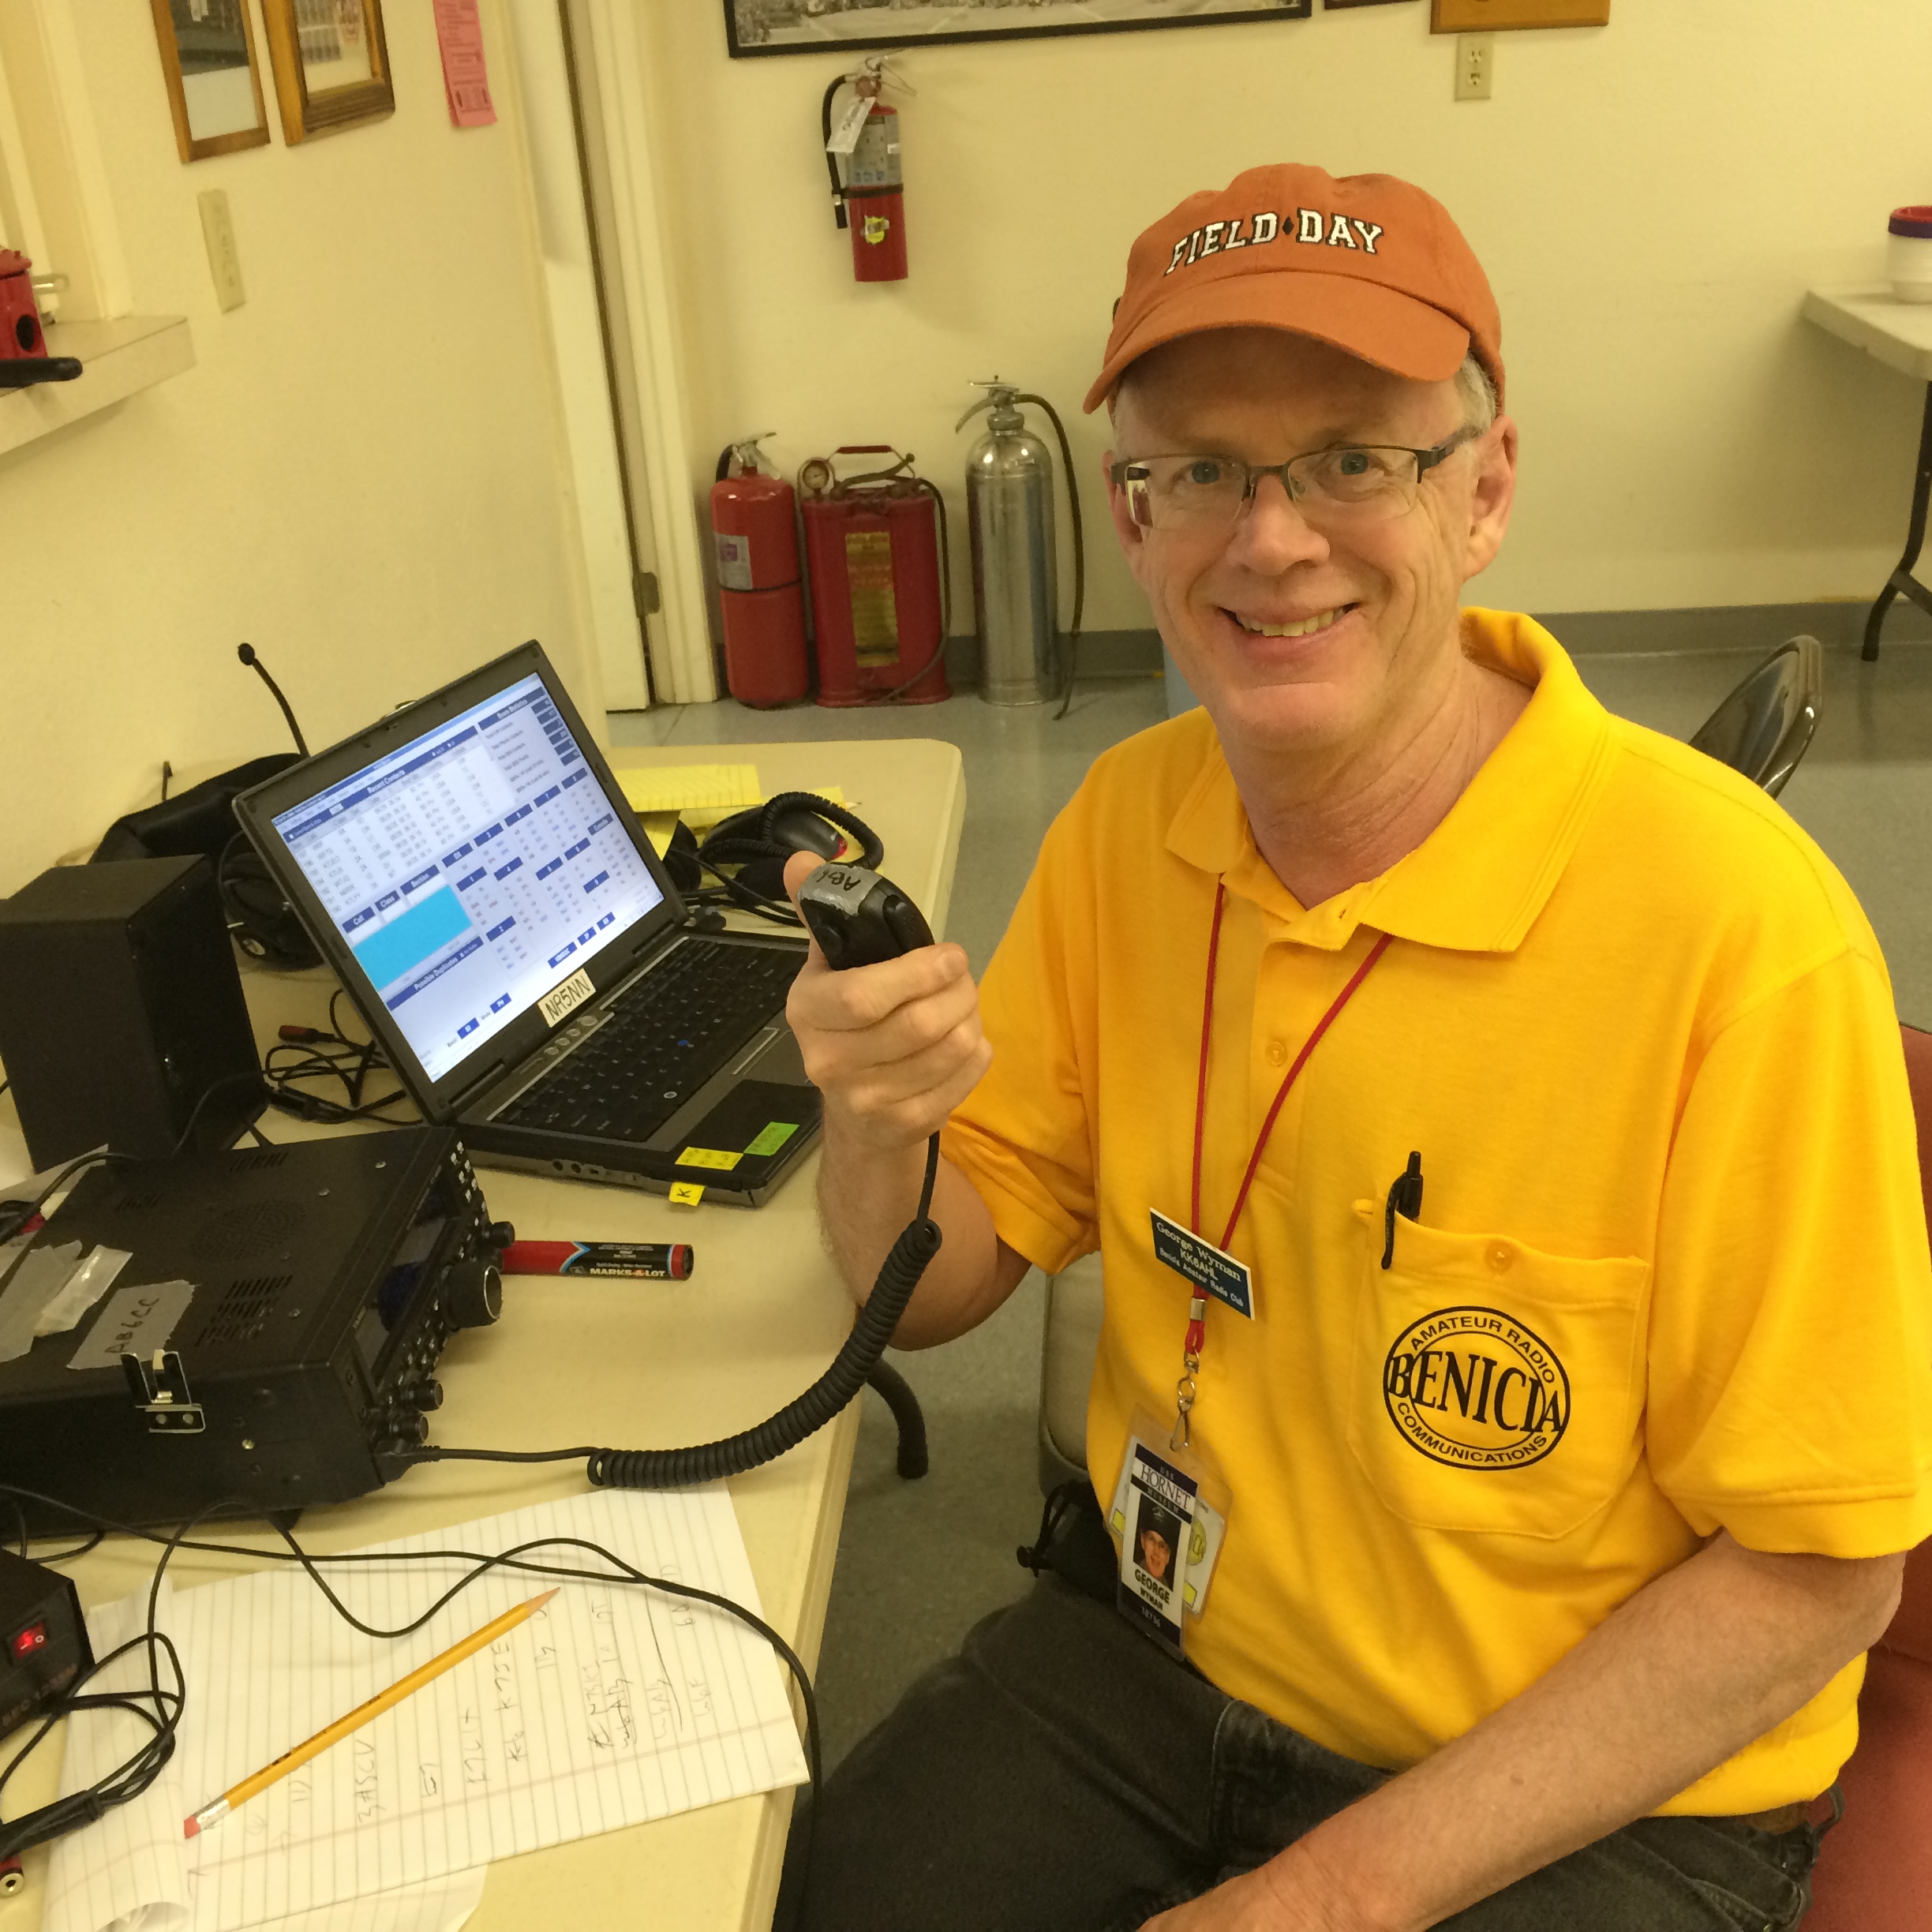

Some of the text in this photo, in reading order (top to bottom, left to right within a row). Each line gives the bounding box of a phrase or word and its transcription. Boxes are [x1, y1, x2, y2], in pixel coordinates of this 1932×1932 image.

[1163, 207, 1384, 277] FIELD DAY
[545, 975, 592, 1021] NR5NN
[676, 1188, 691, 1198] K
[1156, 1222, 1241, 1282] George Wyman
[1410, 1316, 1556, 1383] AMATEUR RADIO
[1387, 1350, 1564, 1433] BENICIA
[1398, 1402, 1548, 1462] COMMUNICATIONS
[1140, 1464, 1191, 1510] HORNET
[1135, 1569, 1170, 1604] GEORGE
[1140, 1587, 1163, 1611] WYMAN
